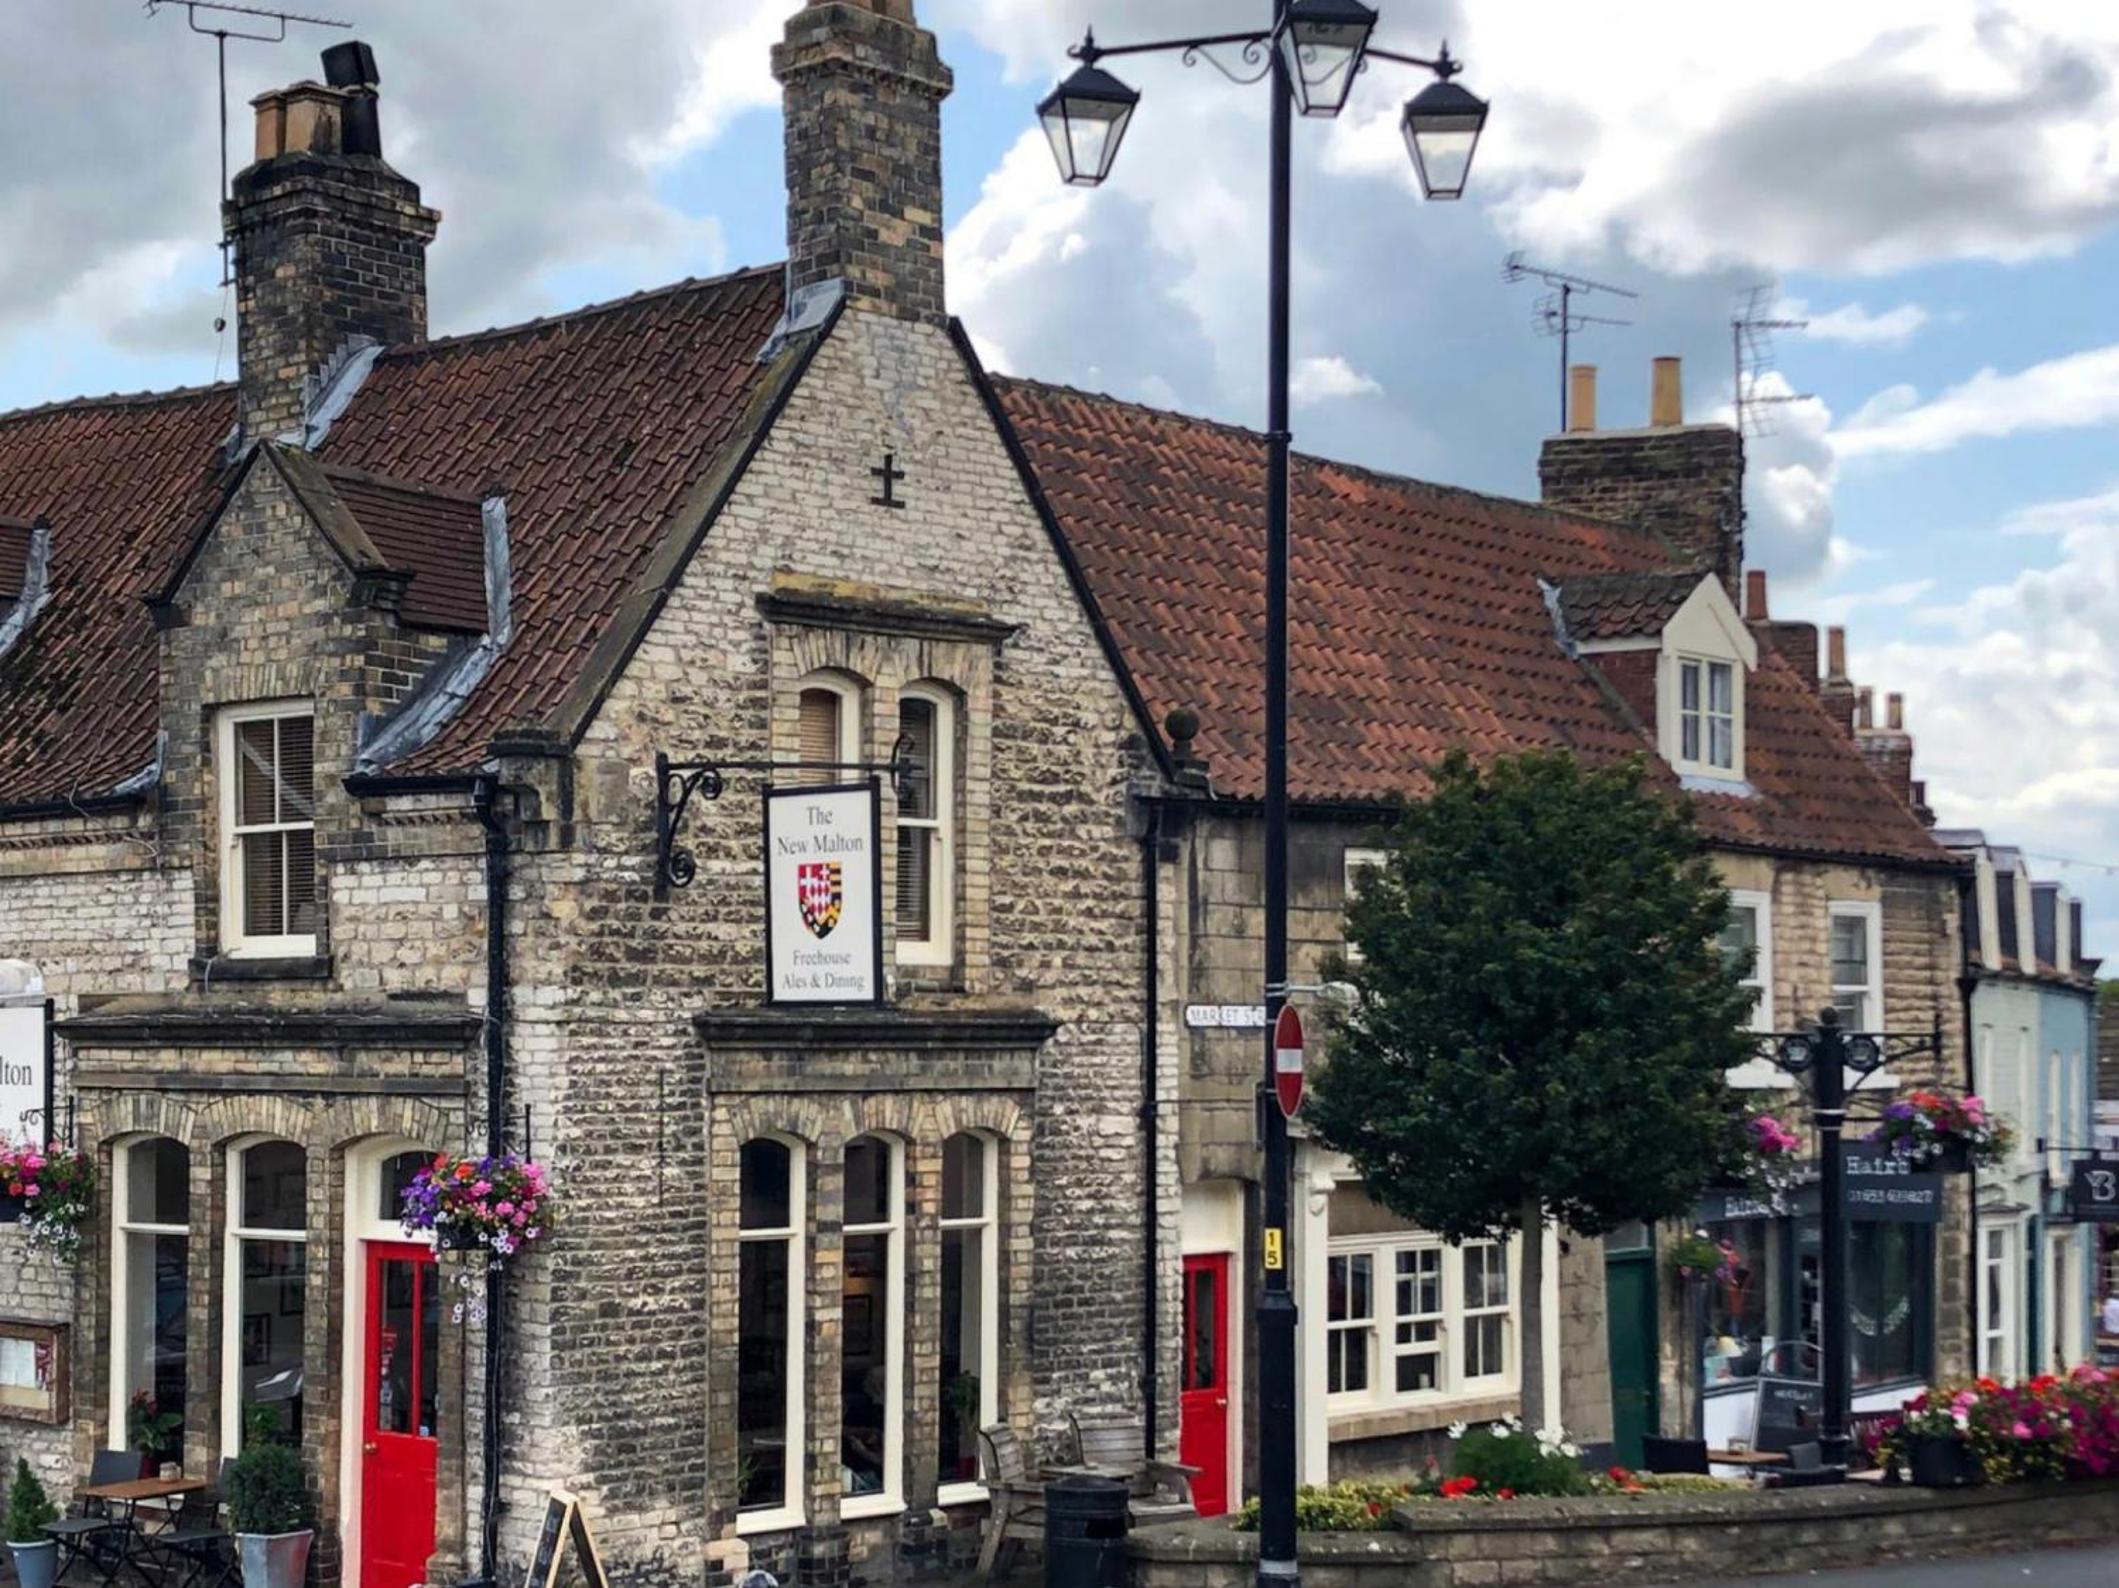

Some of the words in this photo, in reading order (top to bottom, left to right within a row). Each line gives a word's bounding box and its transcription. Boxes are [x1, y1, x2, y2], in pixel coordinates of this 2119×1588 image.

[806, 806, 833, 825] The
[777, 836, 809, 855] New
[813, 833, 864, 853] Malton
[792, 949, 852, 966] Freehouse
[782, 974, 807, 991] Ales
[809, 974, 821, 989] &
[824, 972, 865, 992] Dining
[1267, 1231, 1278, 1266] 15
